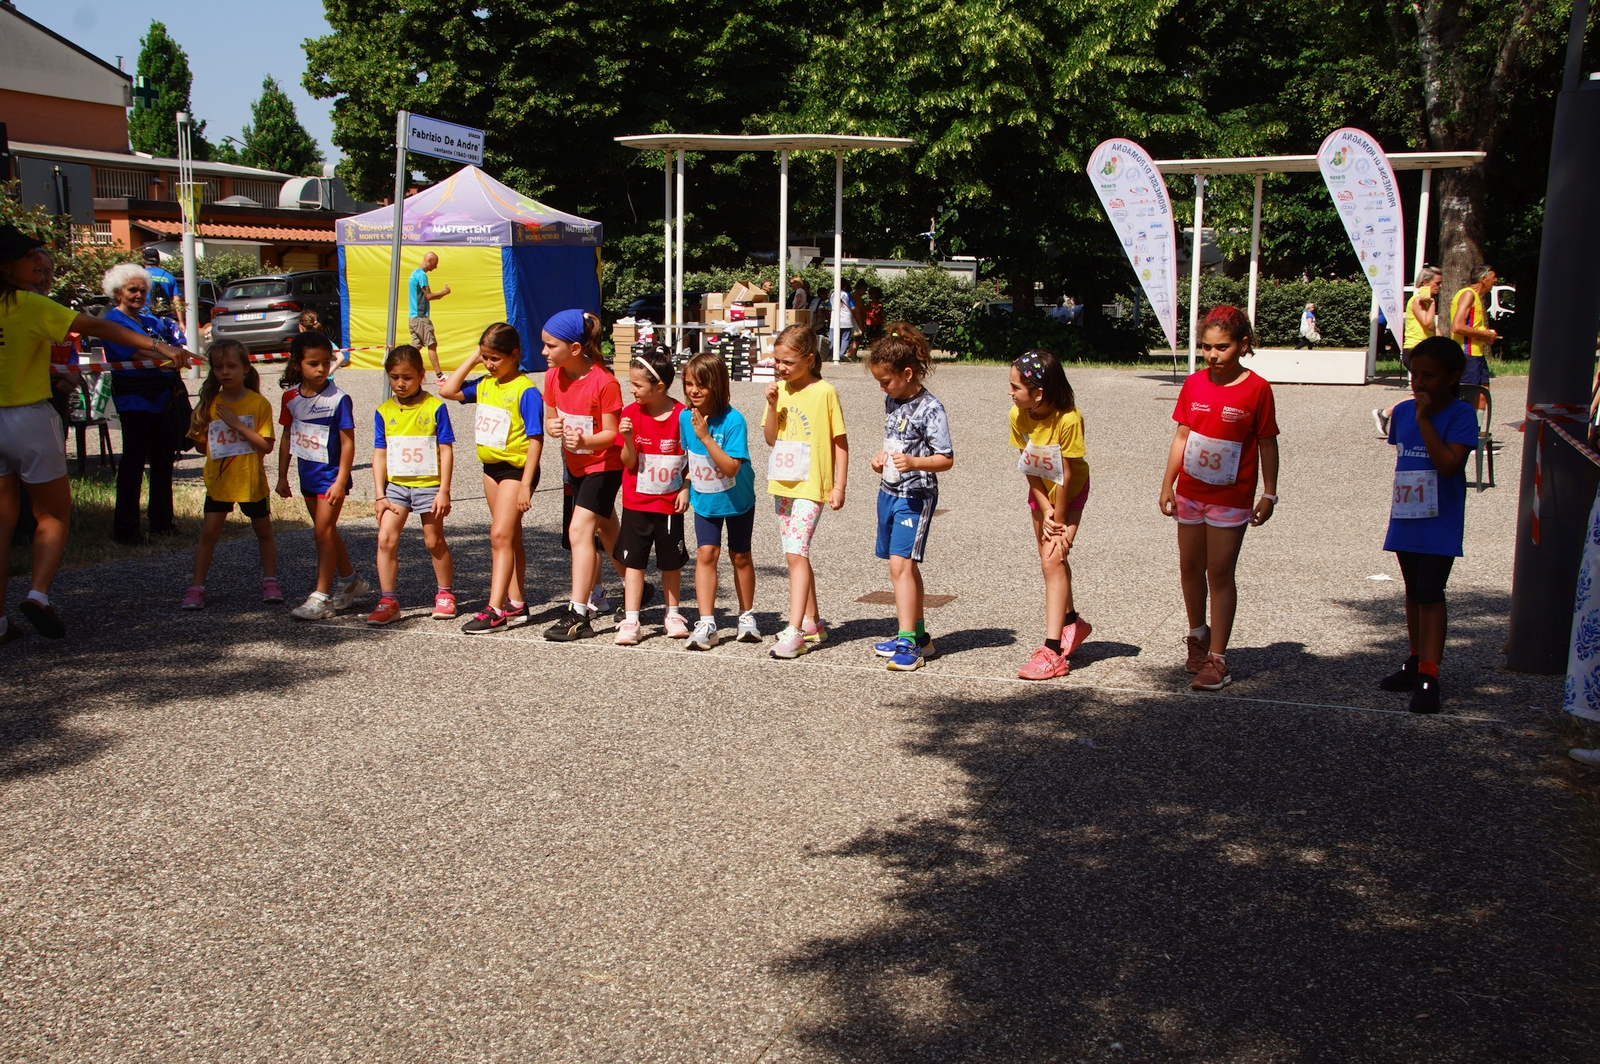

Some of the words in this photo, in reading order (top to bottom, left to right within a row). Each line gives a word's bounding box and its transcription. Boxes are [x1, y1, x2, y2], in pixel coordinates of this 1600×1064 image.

[412, 128, 442, 142] Fabrizio
[444, 136, 454, 146] De
[434, 147, 452, 155] cantante
[454, 151, 480, 161] (1940-1999)
[432, 224, 493, 234] MASTERTENT
[565, 225, 595, 234] MASTERTENT
[467, 235, 500, 243] sponsoring
[475, 415, 501, 434] 257
[217, 429, 247, 445] 43
[295, 431, 320, 450] 259
[401, 448, 424, 463] 55
[775, 453, 795, 468] 58
[1024, 450, 1054, 471] 375
[1198, 450, 1222, 470] 53
[648, 466, 680, 482] 106
[695, 465, 725, 481] 428
[1395, 485, 1424, 504] 371
